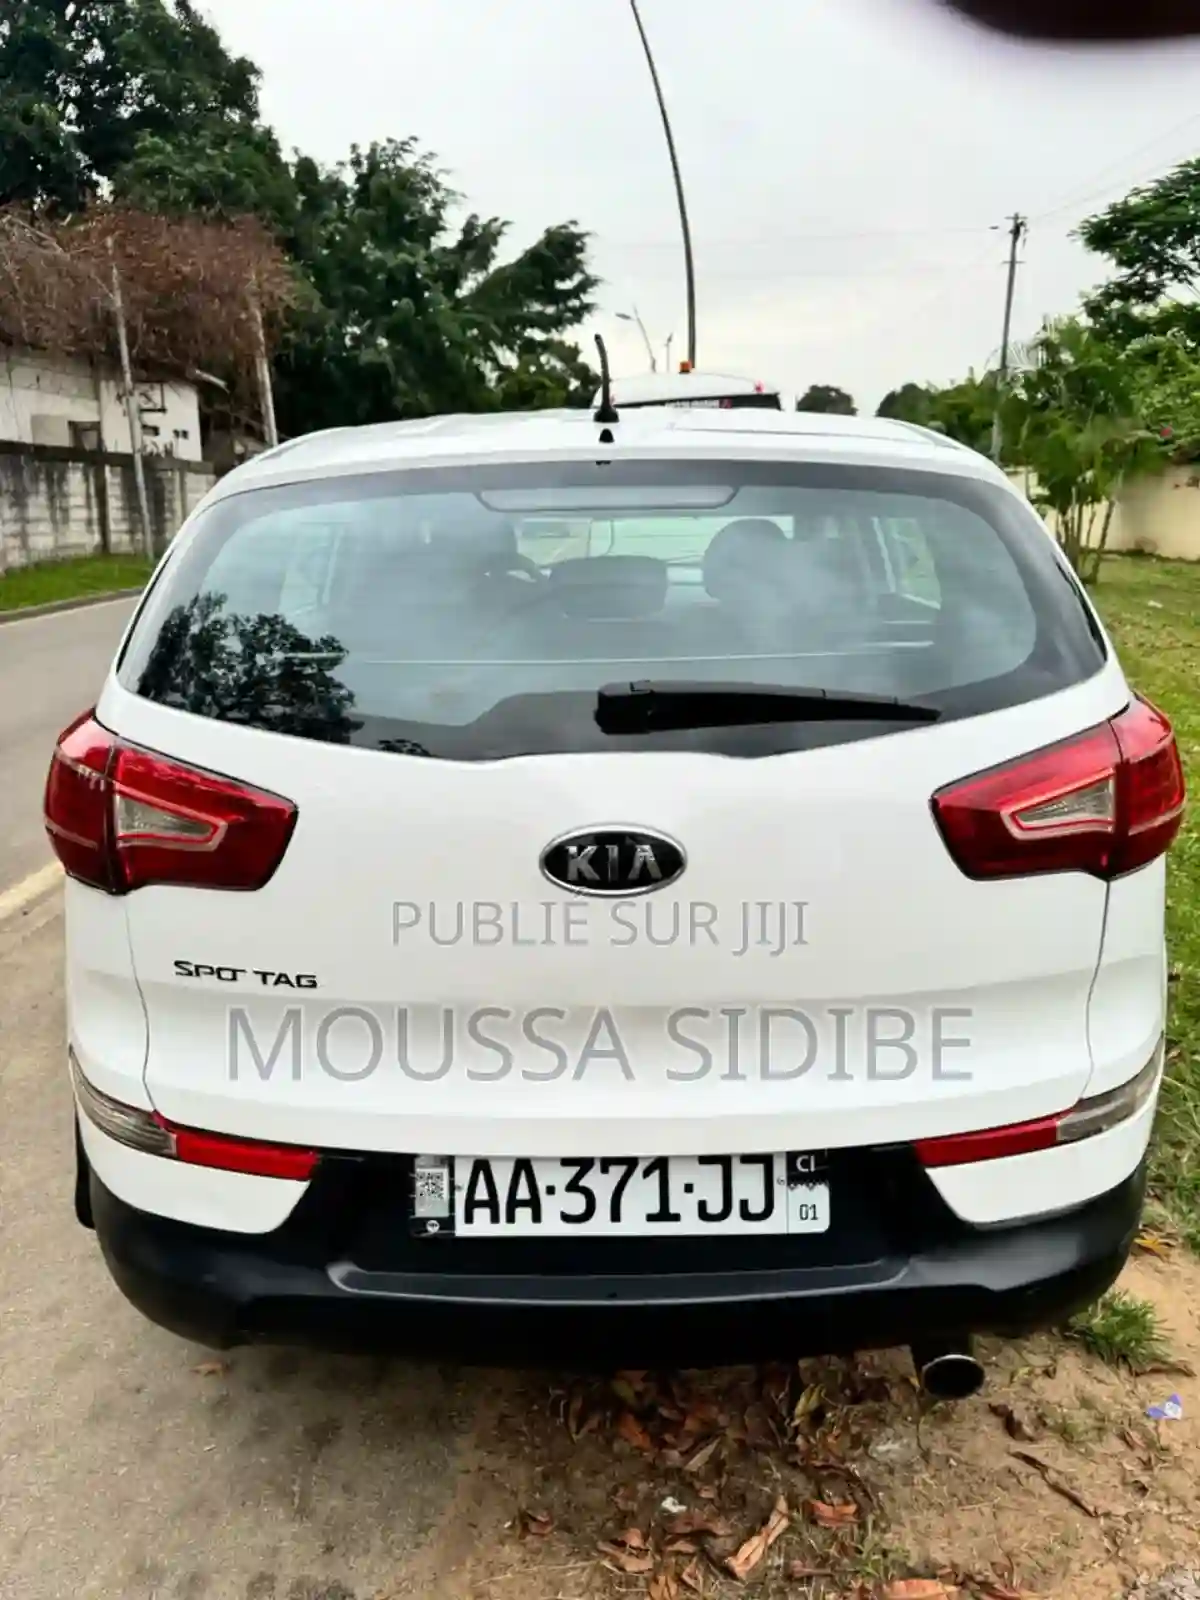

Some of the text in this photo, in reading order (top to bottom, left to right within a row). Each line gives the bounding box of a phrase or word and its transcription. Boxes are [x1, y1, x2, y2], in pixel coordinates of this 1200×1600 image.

[566, 845, 663, 881] KIA
[795, 1155, 815, 1172] CI
[799, 1203, 819, 1221] 01
